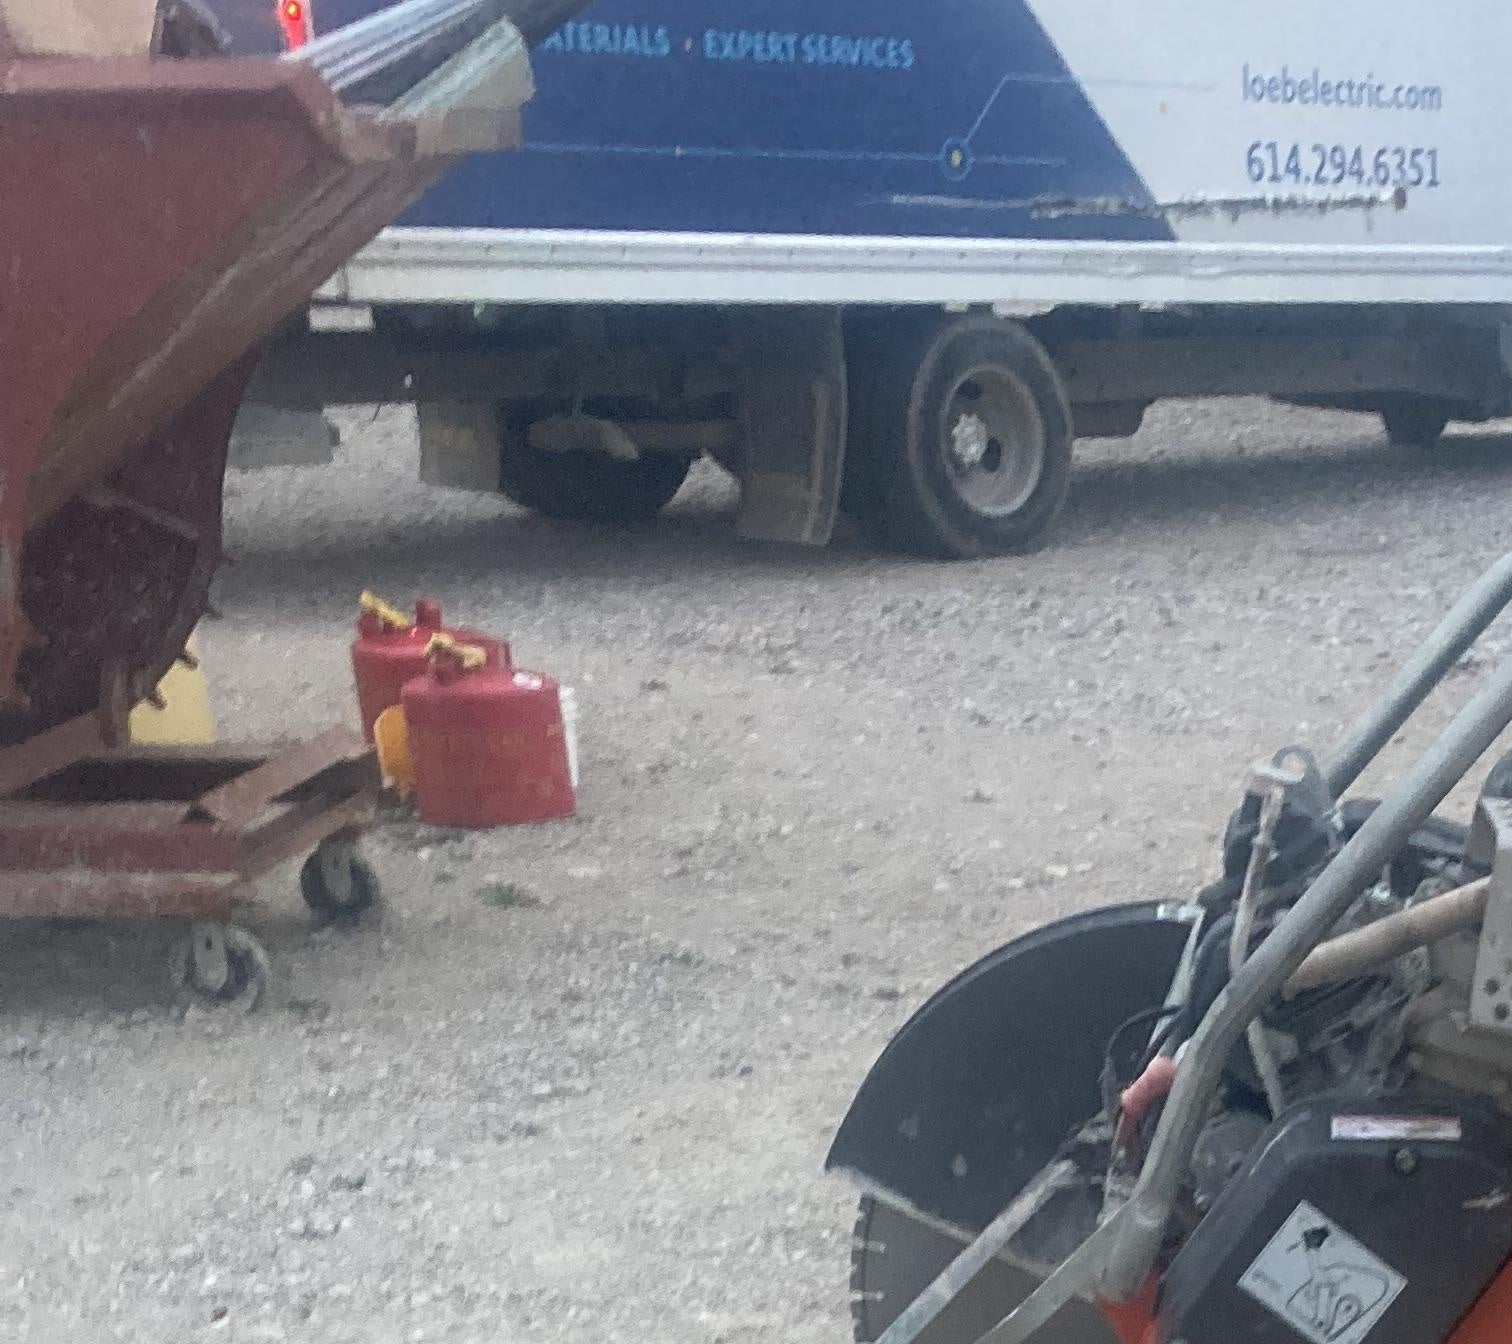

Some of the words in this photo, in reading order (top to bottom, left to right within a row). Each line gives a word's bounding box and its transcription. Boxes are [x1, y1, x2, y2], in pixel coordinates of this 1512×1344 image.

[538, 20, 671, 57] ATERIALS
[704, 28, 799, 63] EXPERT
[801, 33, 915, 70] SERVICES
[1242, 62, 1443, 111] loebelectric.com
[1246, 141, 1440, 187] 614.294.6351
